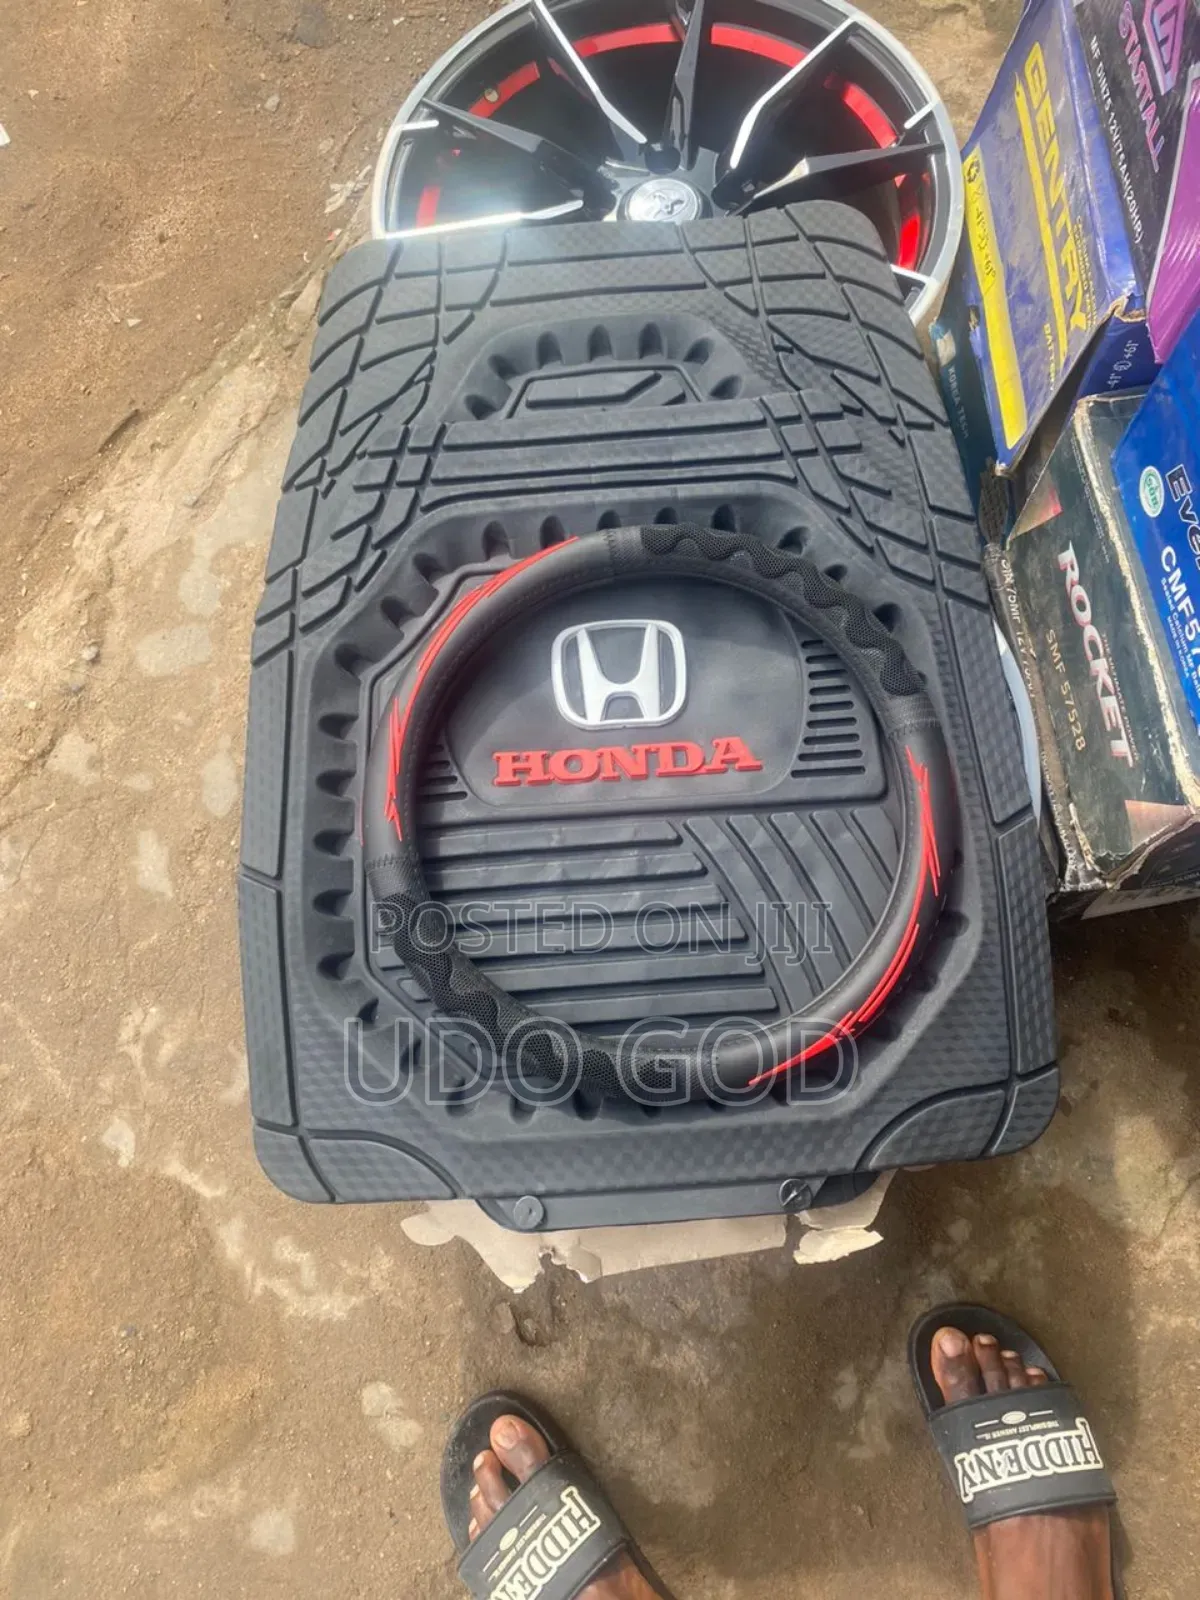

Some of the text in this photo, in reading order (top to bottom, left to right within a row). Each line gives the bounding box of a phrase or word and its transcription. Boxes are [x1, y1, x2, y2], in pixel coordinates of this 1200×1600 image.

[1024, 41, 1088, 331] GENTRY
[1045, 629, 1087, 751] SMF 57528
[1058, 540, 1133, 767] ROCKET
[492, 735, 763, 786] HONDA
[954, 1417, 1103, 1503] HIDDENY
